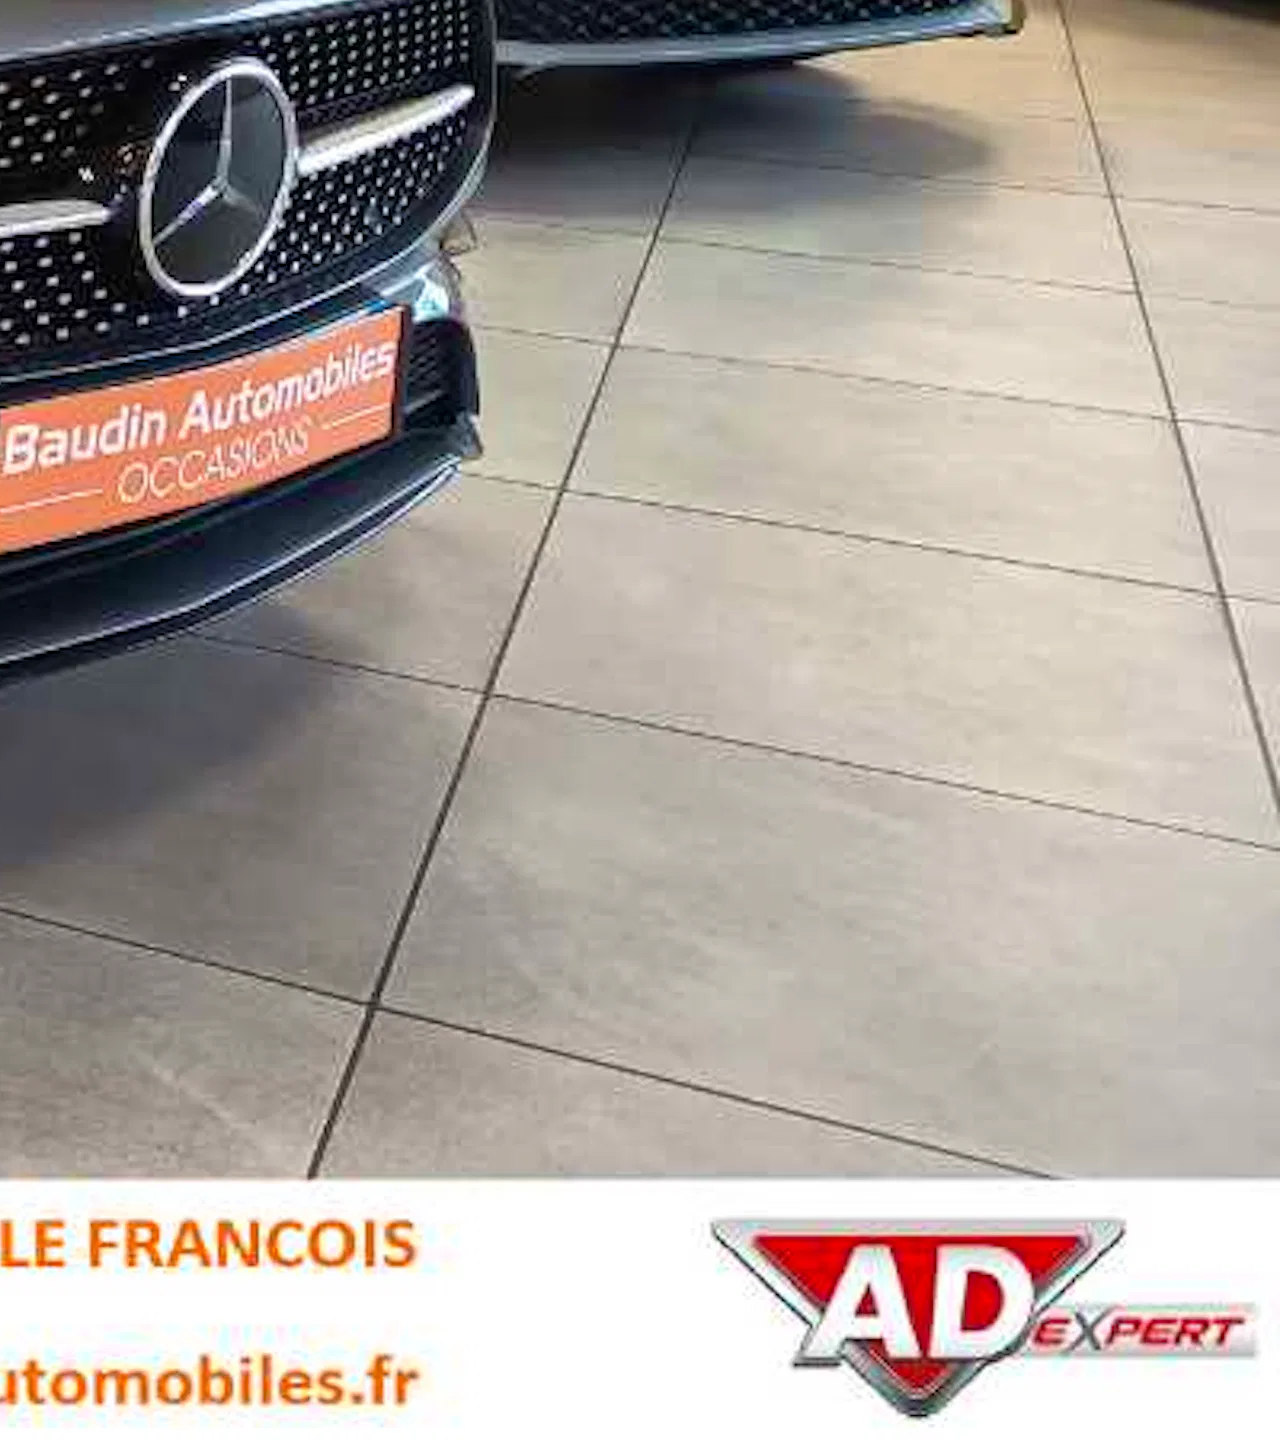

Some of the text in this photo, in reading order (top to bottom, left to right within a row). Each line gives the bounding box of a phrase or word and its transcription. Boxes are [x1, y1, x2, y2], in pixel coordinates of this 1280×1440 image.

[1, 341, 396, 474] Baudin Automobiles
[116, 419, 310, 504] OCCASIONS
